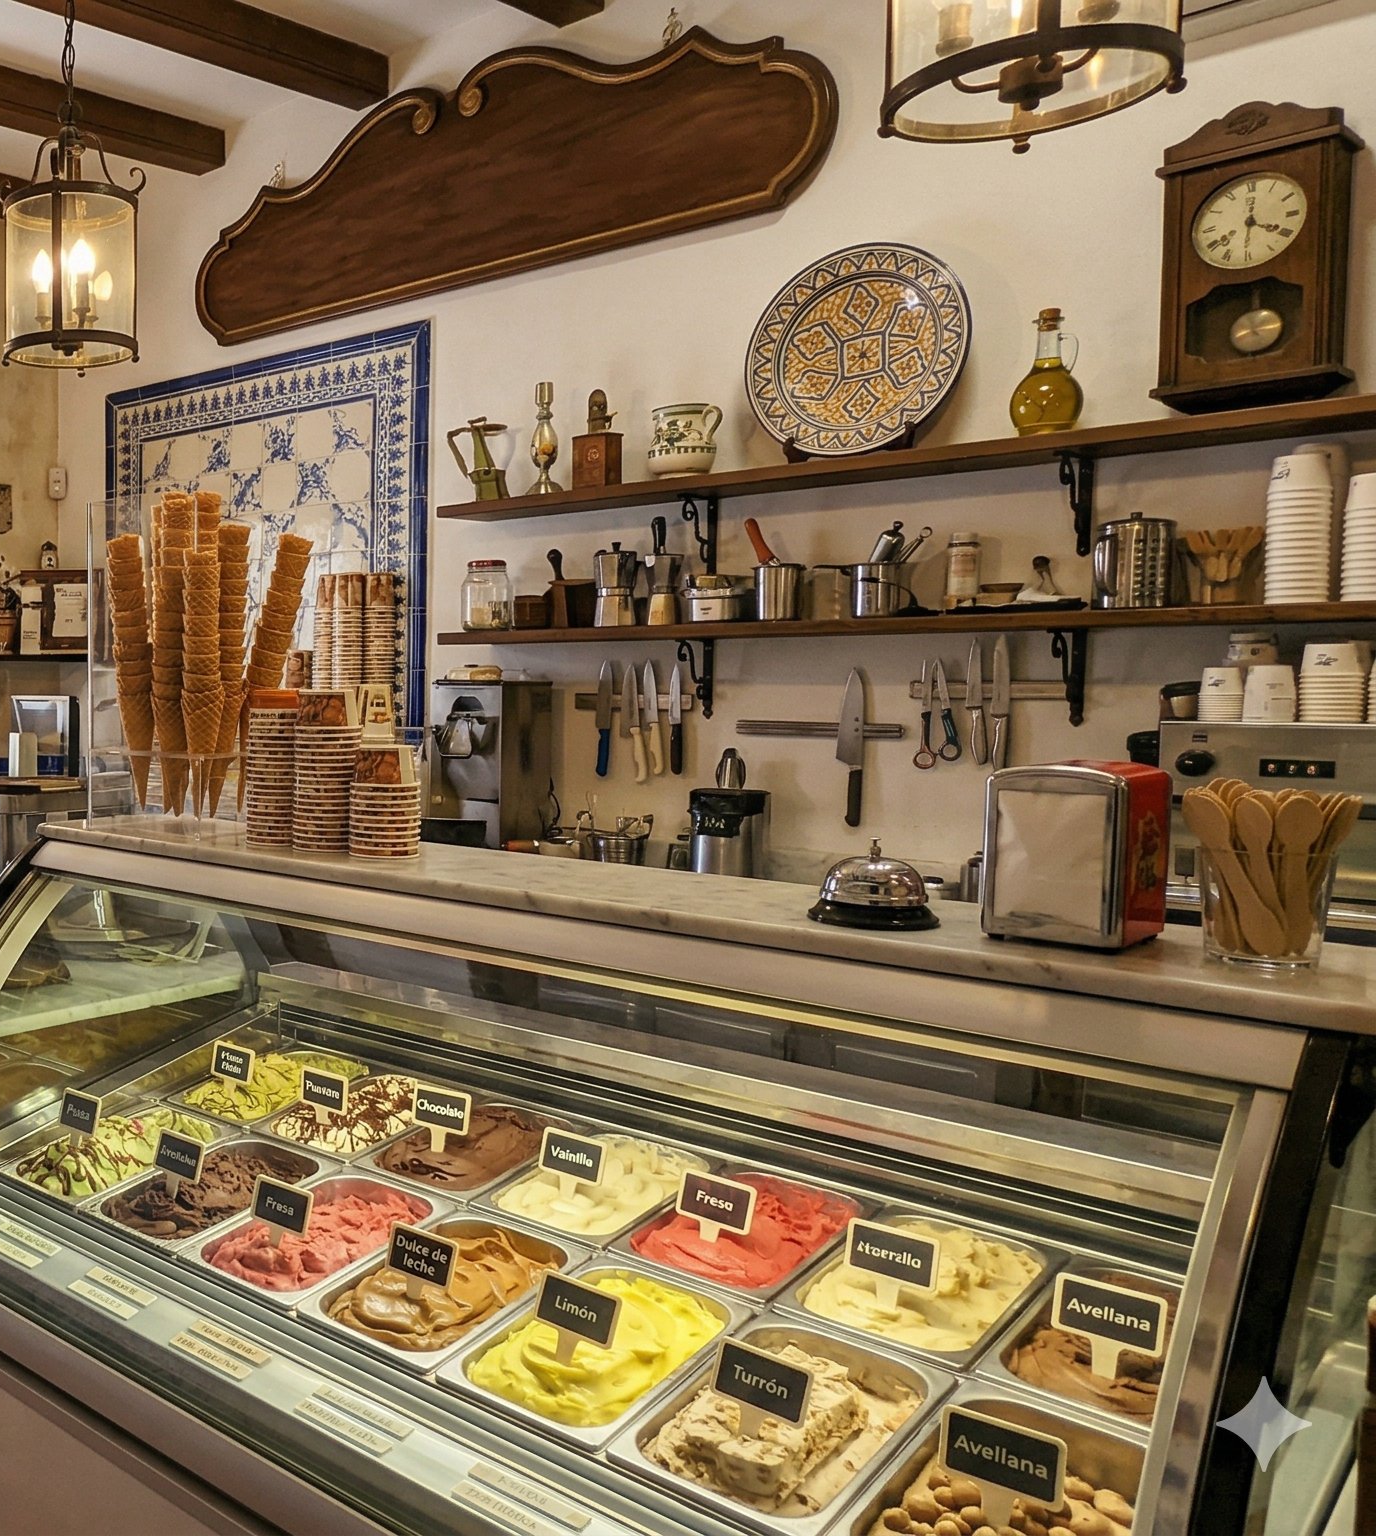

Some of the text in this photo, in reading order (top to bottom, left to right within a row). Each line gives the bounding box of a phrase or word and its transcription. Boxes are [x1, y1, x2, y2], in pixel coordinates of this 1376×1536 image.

[265, 1196, 294, 1216] Fresa
[695, 1189, 734, 1212] Fresa
[395, 1234, 448, 1264] Dulce de
[402, 1252, 436, 1277] leche
[554, 1295, 597, 1323] Limón
[1066, 1297, 1151, 1333] Avellana
[733, 1364, 789, 1400] Turrón
[953, 1434, 1049, 1481] Avellana
